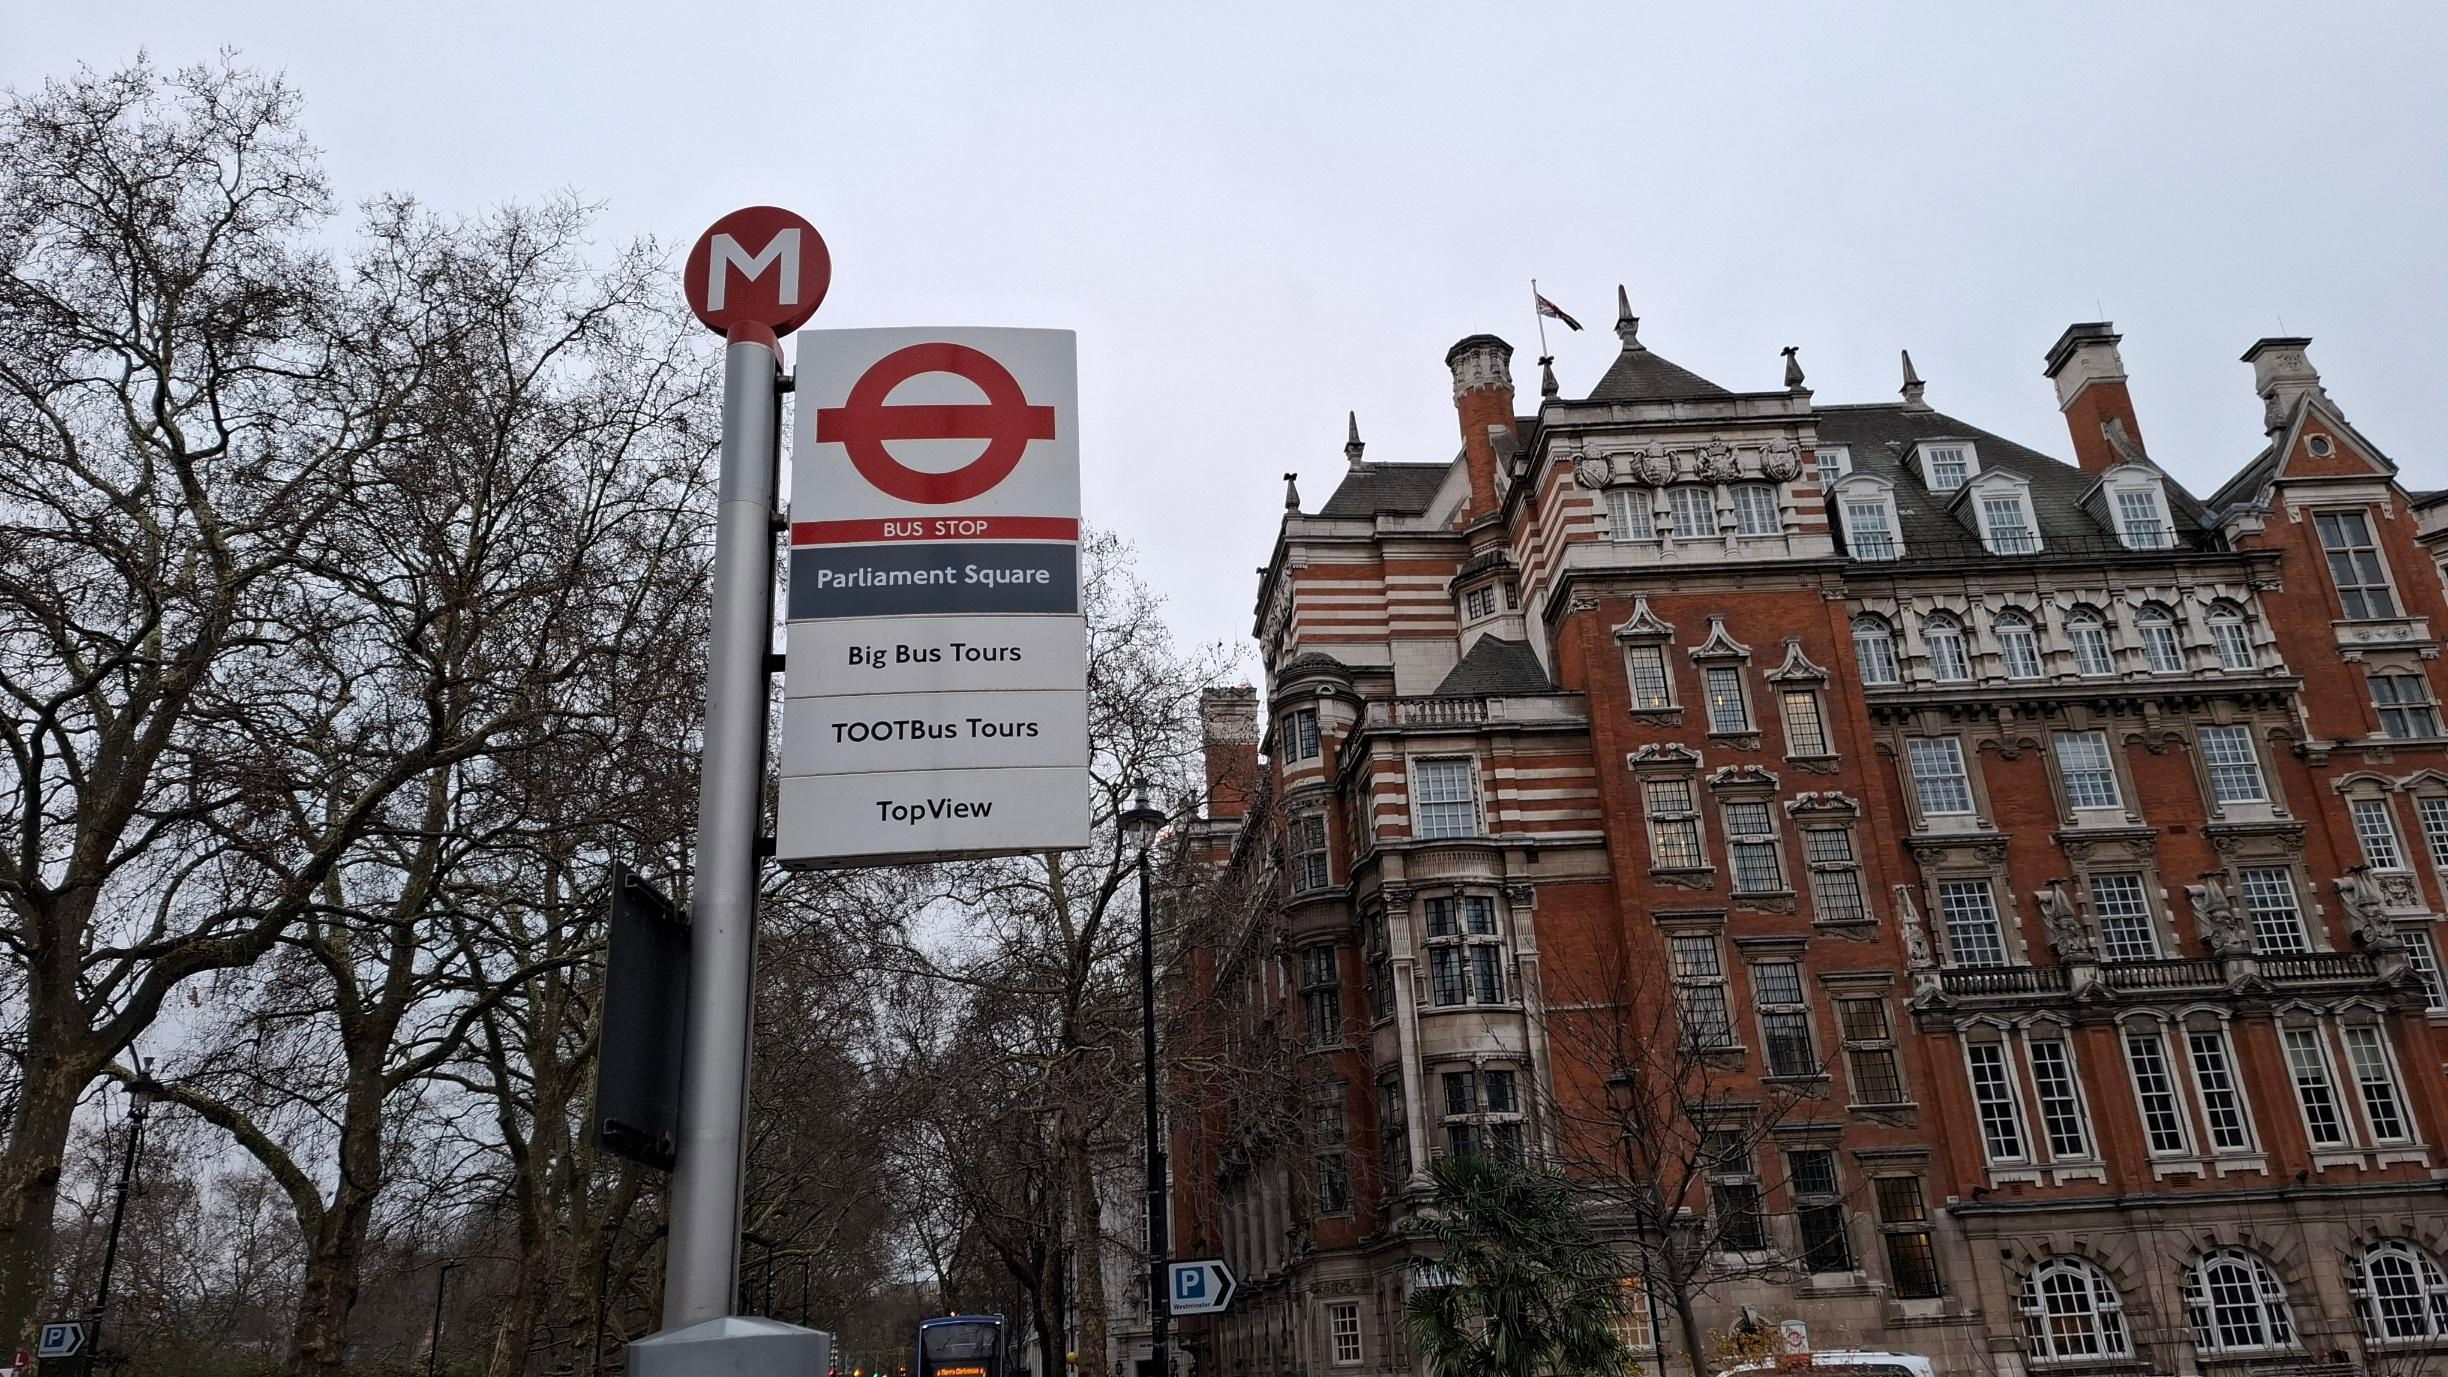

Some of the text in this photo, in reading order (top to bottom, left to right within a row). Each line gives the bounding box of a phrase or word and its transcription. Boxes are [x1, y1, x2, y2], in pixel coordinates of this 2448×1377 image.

[706, 227, 801, 312] M
[883, 520, 988, 537] BUS STOP
[817, 564, 1050, 589] Parliament Square
[848, 642, 1022, 670] Big Bus Tours
[831, 718, 1039, 744] TOOTBus Tours
[875, 798, 993, 826] TopView
[1181, 1270, 1199, 1296] P
[1173, 1302, 1211, 1310] Westminster
[48, 1328, 62, 1346] P
[15, 1353, 24, 1366] L
